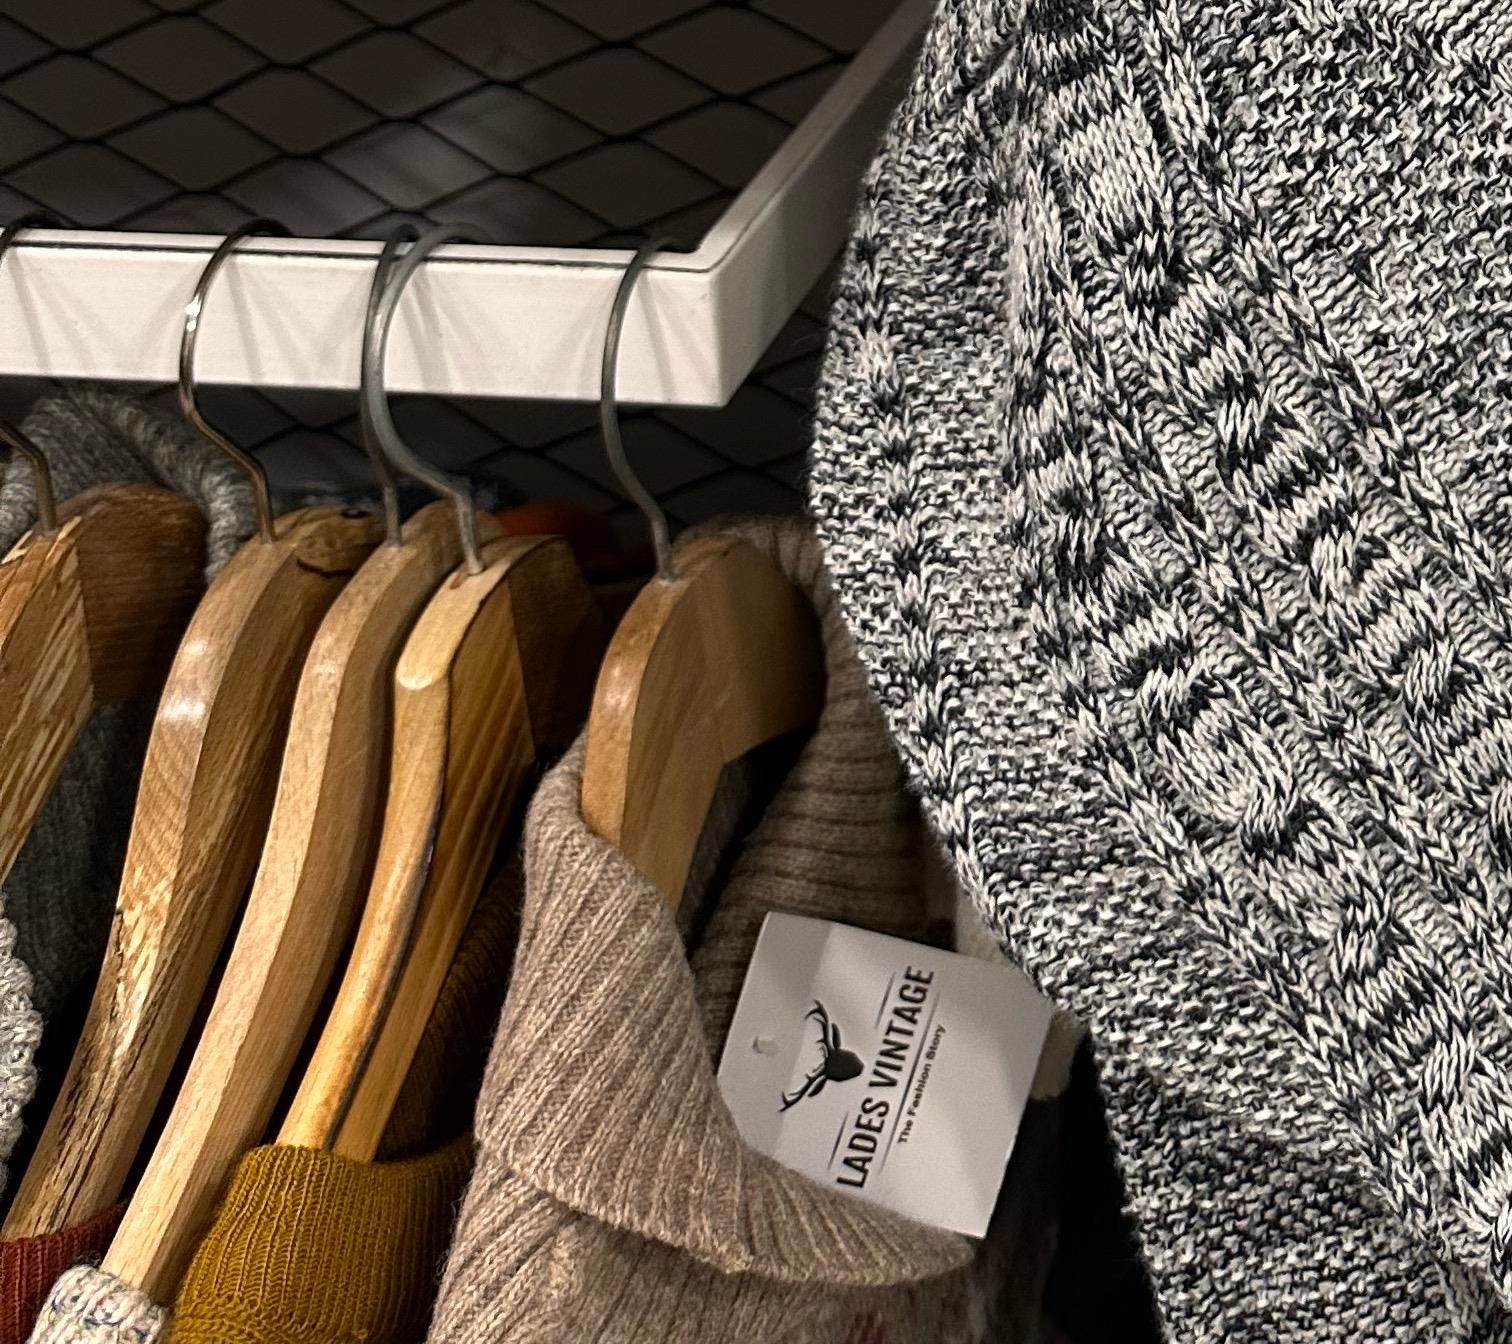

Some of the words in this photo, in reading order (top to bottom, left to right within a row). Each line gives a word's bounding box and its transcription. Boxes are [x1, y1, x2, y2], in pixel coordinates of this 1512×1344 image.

[836, 1097, 891, 1189] LADES
[868, 965, 934, 1089] VINTAGE
[897, 1119, 914, 1143] The
[906, 1062, 932, 1117] Fashion
[926, 1023, 946, 1060] Story
